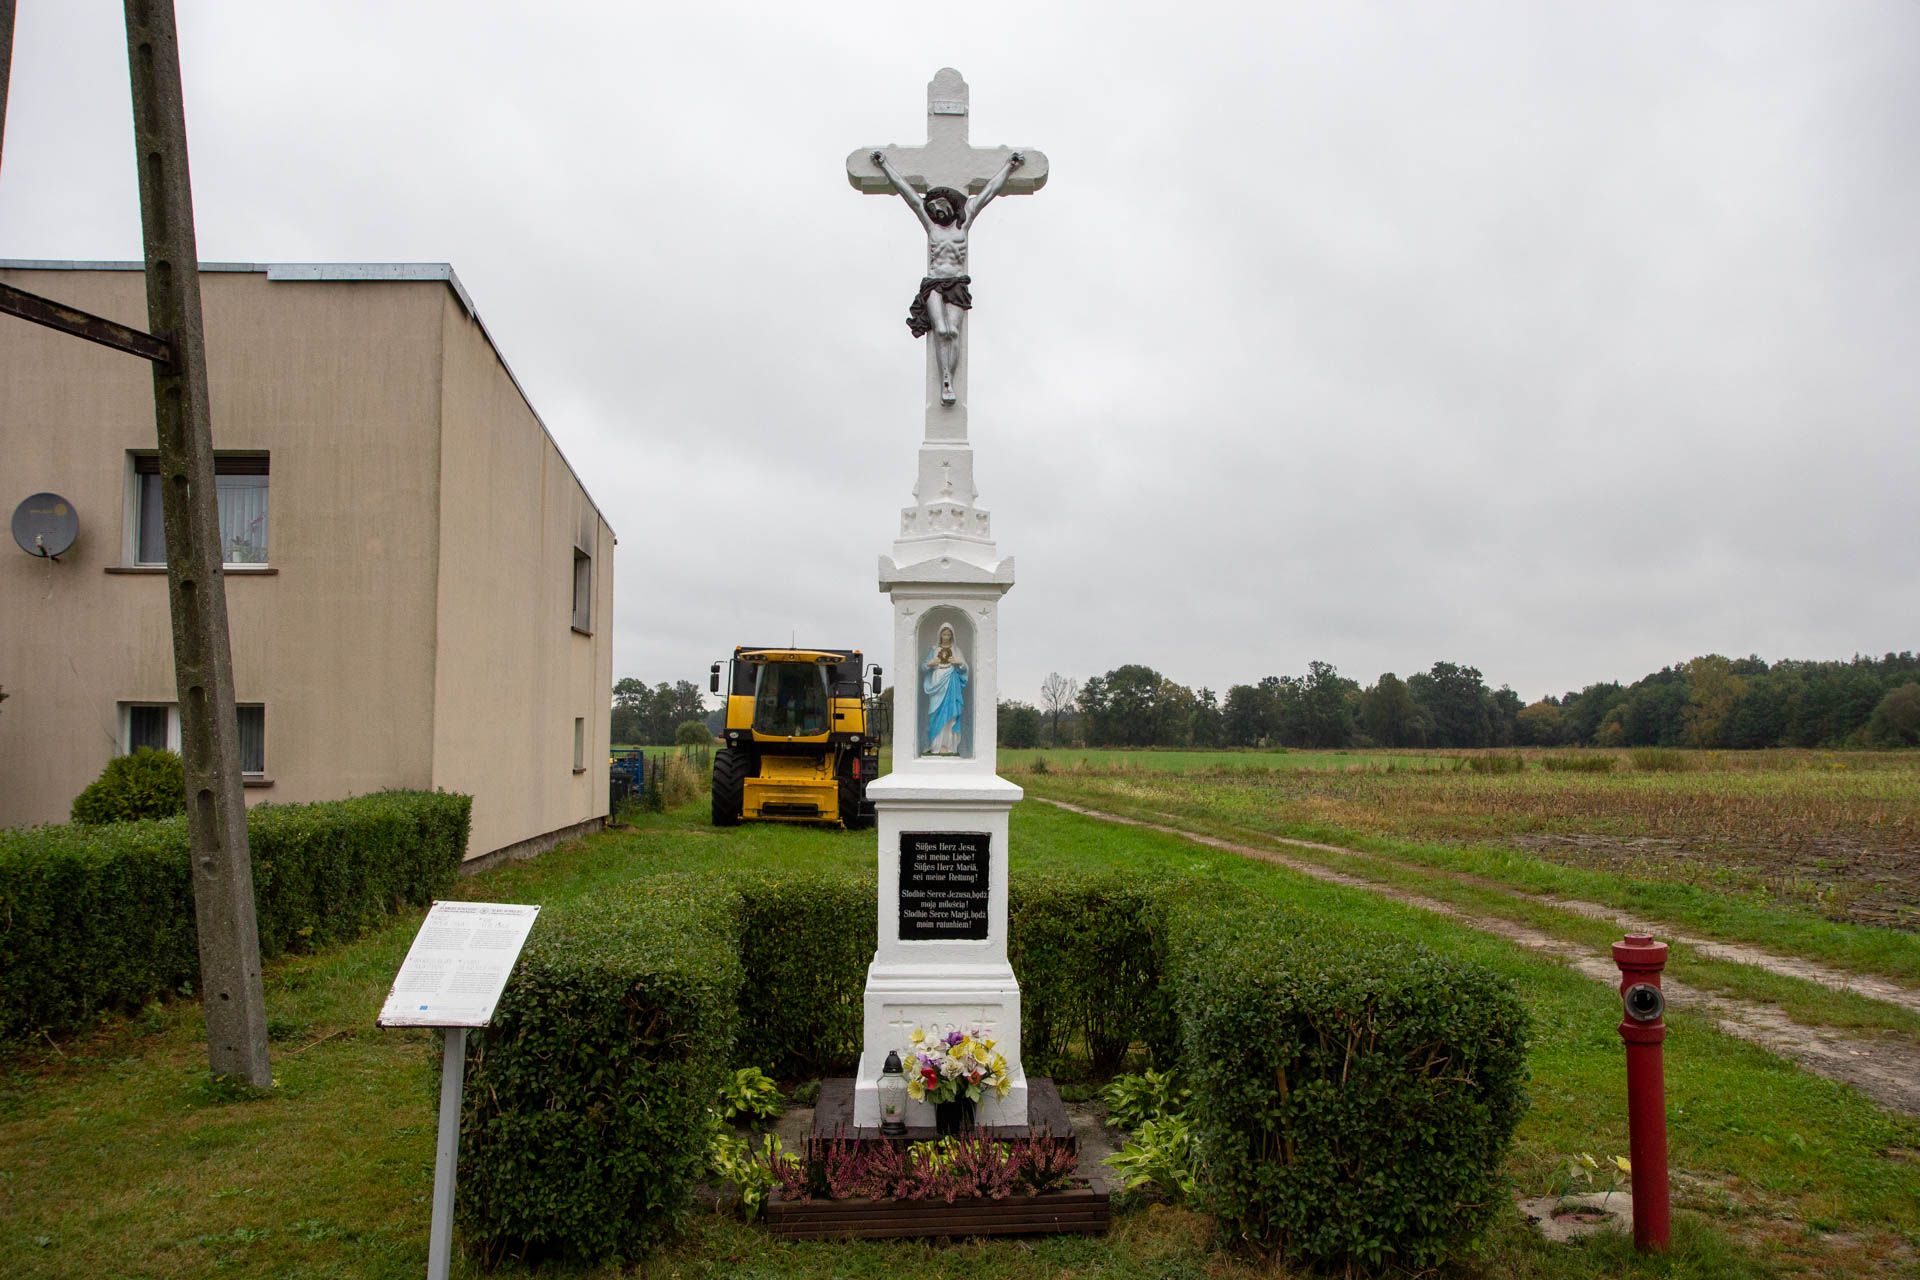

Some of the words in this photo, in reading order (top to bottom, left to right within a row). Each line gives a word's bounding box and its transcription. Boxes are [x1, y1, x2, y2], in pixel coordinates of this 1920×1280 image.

[939, 842, 956, 851] Herz
[929, 853, 950, 861] meine
[937, 863, 954, 871] Herz
[912, 873, 923, 881] sei
[925, 873, 946, 881] meine
